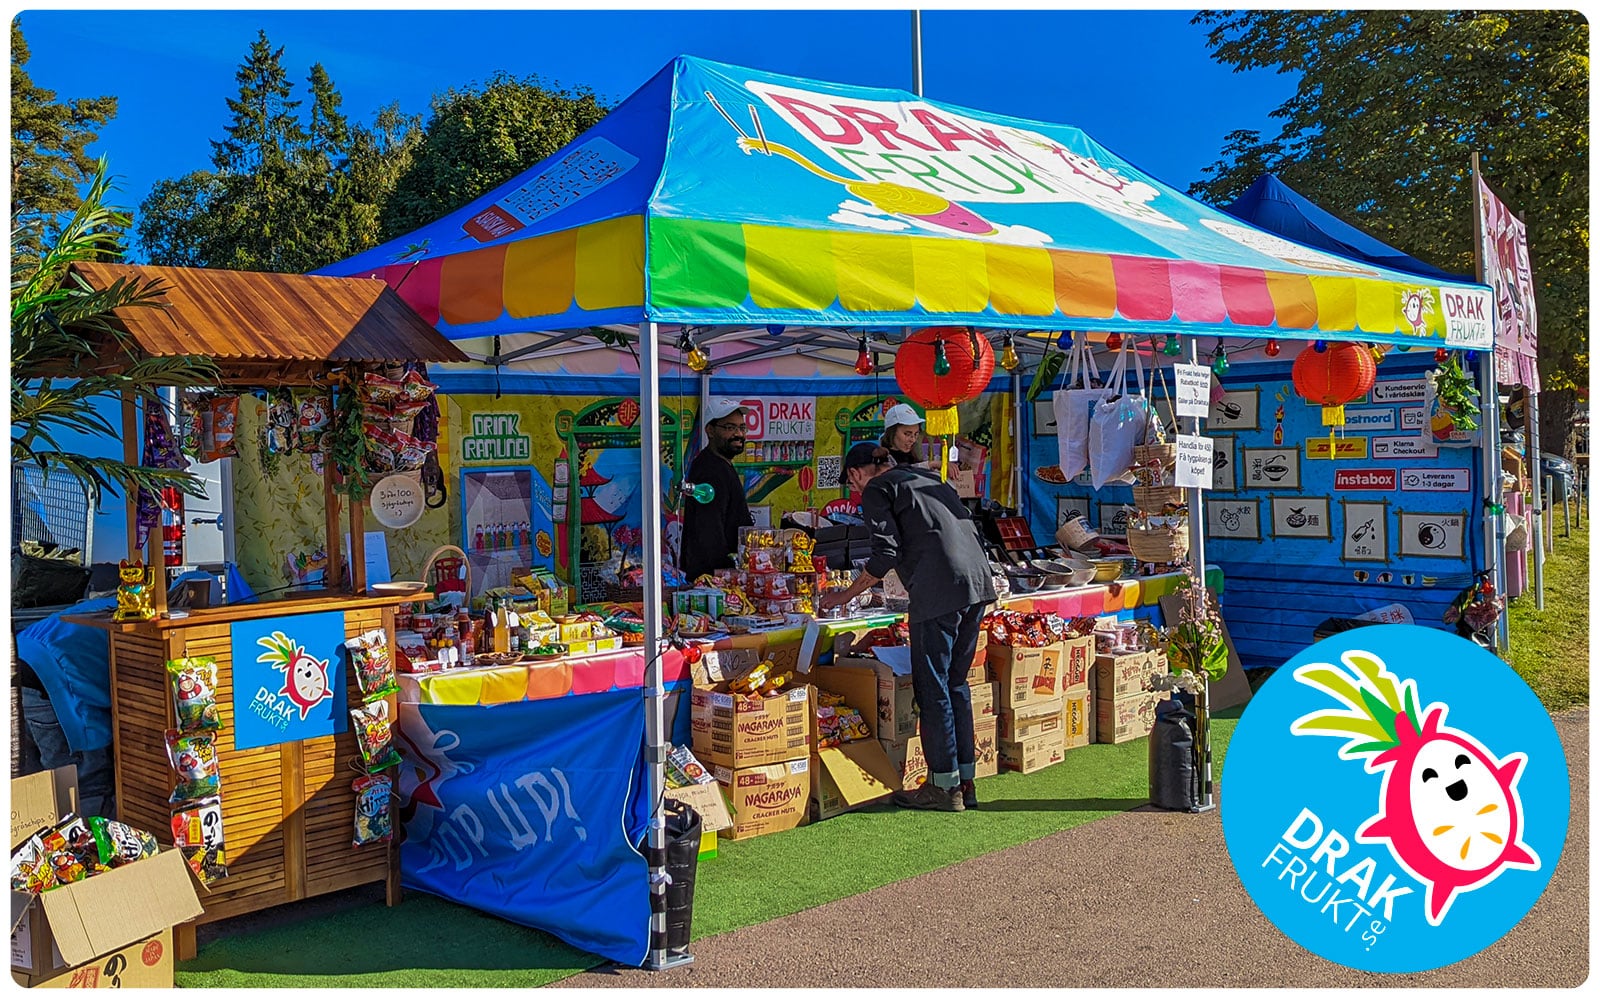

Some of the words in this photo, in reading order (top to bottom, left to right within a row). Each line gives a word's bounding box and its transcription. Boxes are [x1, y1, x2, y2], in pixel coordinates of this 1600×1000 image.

[1445, 293, 1485, 321] DRAK
[1450, 320, 1480, 340] FRUKT
[769, 403, 812, 420] DRAK
[473, 416, 518, 435] DRINK
[769, 421, 806, 435] FRUKT
[464, 438, 529, 458] RAMUNE!
[1337, 473, 1392, 484] instabox
[255, 686, 296, 721] DRAK
[248, 699, 284, 728] FRUKT
[738, 716, 784, 733] NAGARAYA
[744, 736, 765, 744] CRACKER
[745, 784, 802, 807] NAGARAYA
[752, 809, 780, 820] CRACKER
[781, 806, 796, 814] NUTS
